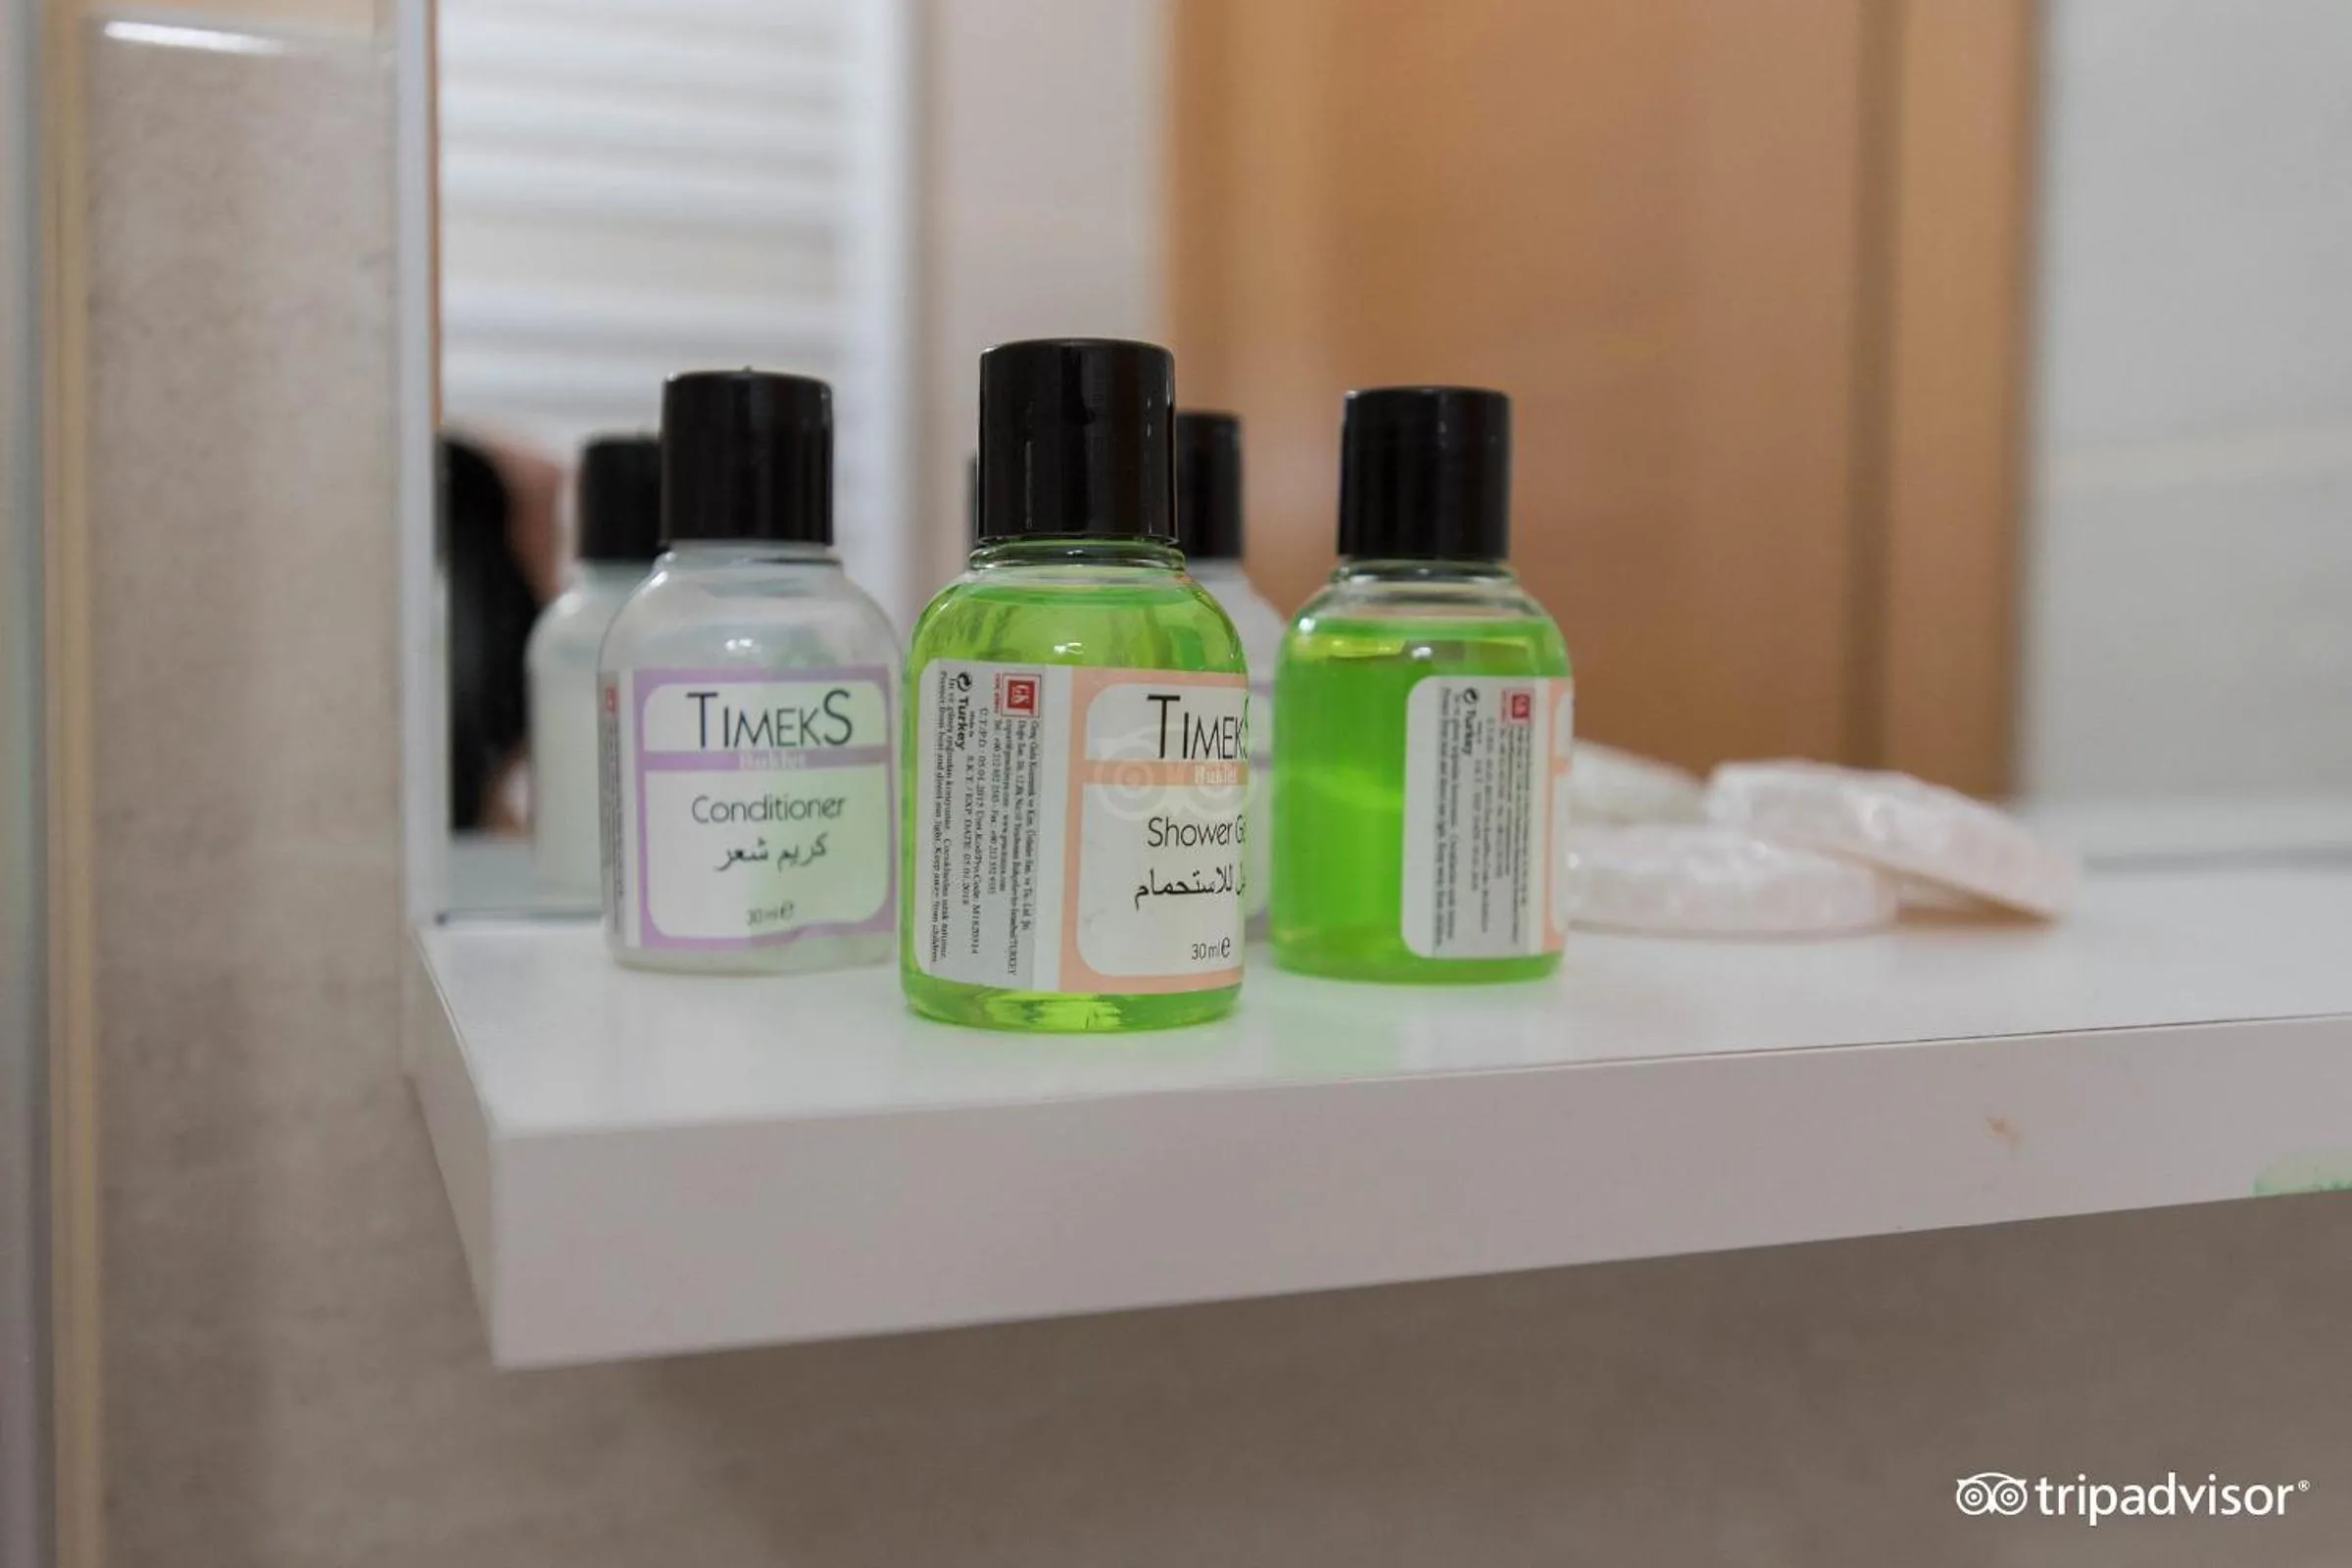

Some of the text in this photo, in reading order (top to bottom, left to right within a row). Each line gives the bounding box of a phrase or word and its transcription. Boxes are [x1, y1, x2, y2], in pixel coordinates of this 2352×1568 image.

[685, 689, 854, 748] TIMEKS
[956, 697, 969, 751] Turkey
[691, 794, 846, 824] Conditioner
[1148, 815, 1232, 847] Shower
